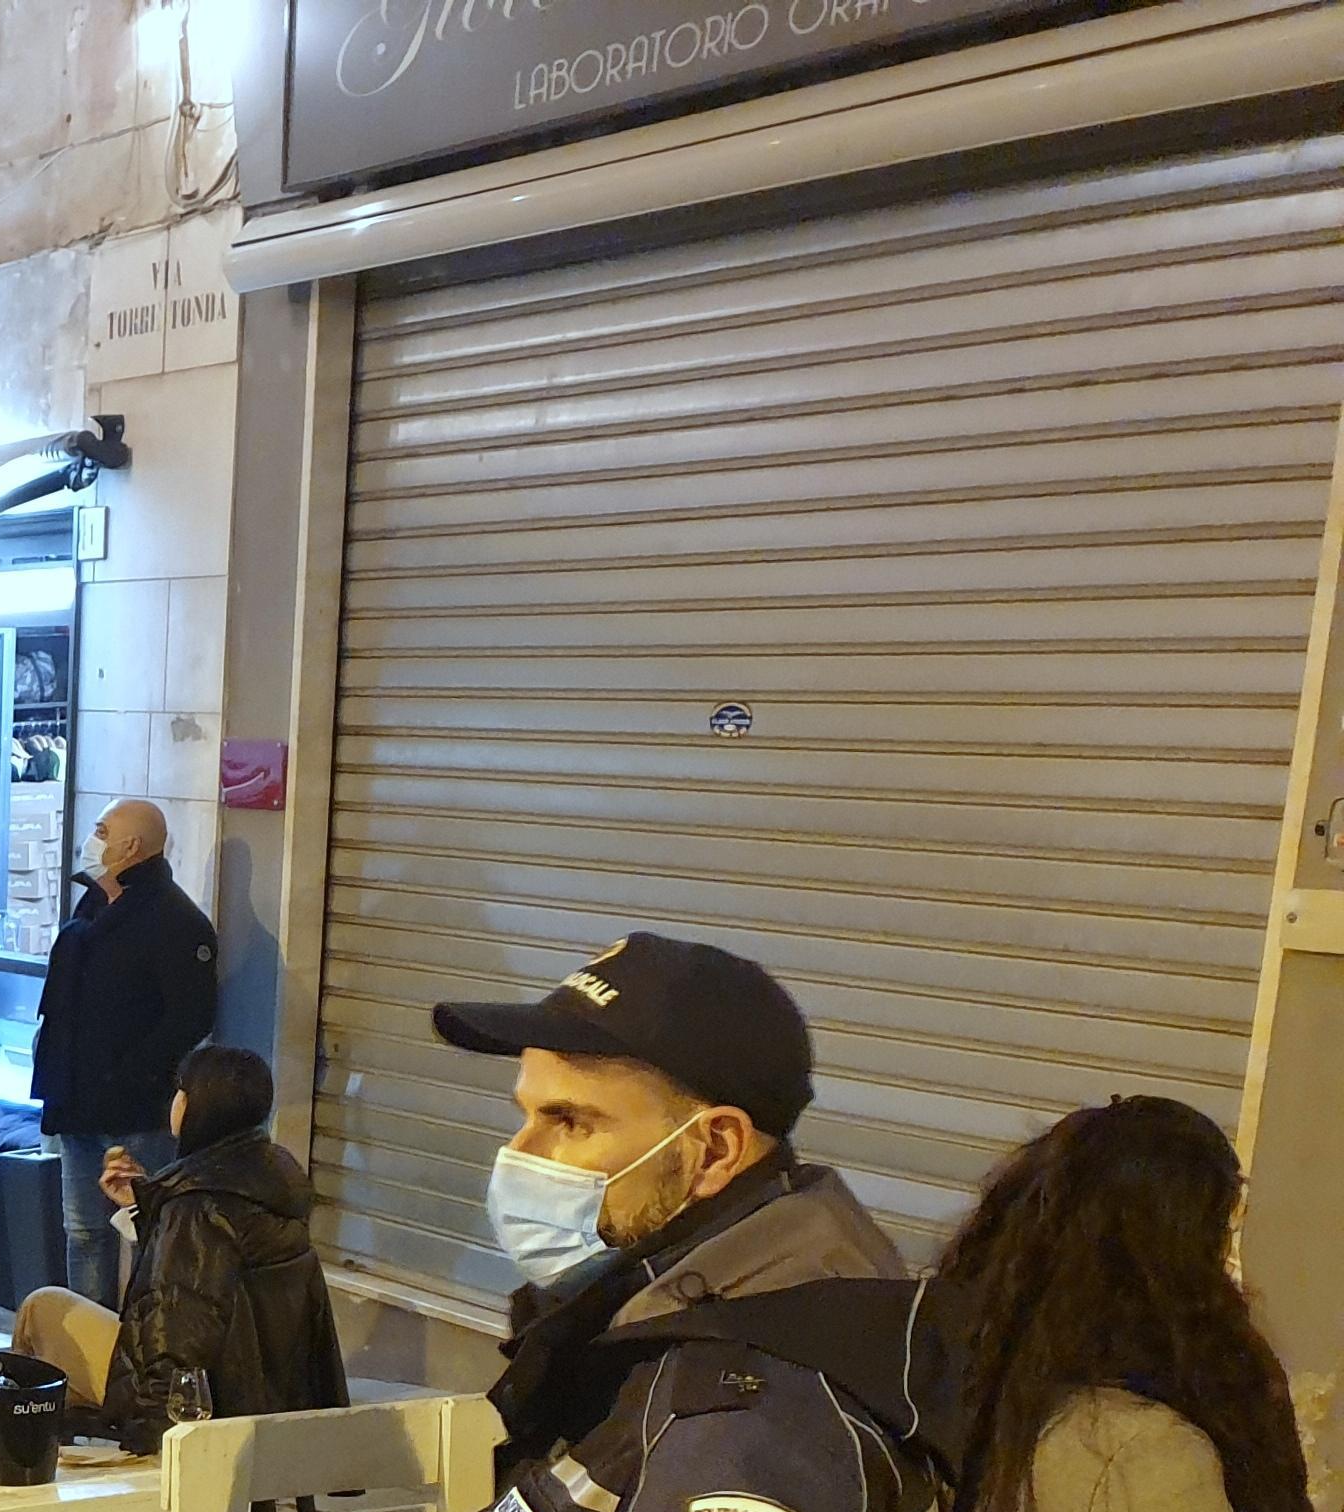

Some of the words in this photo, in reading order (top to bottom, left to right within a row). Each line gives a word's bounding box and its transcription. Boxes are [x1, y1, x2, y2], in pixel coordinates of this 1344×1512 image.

[514, 4, 768, 110] LABORATORIO
[151, 259, 182, 290] VIA
[170, 291, 227, 330] TONDA
